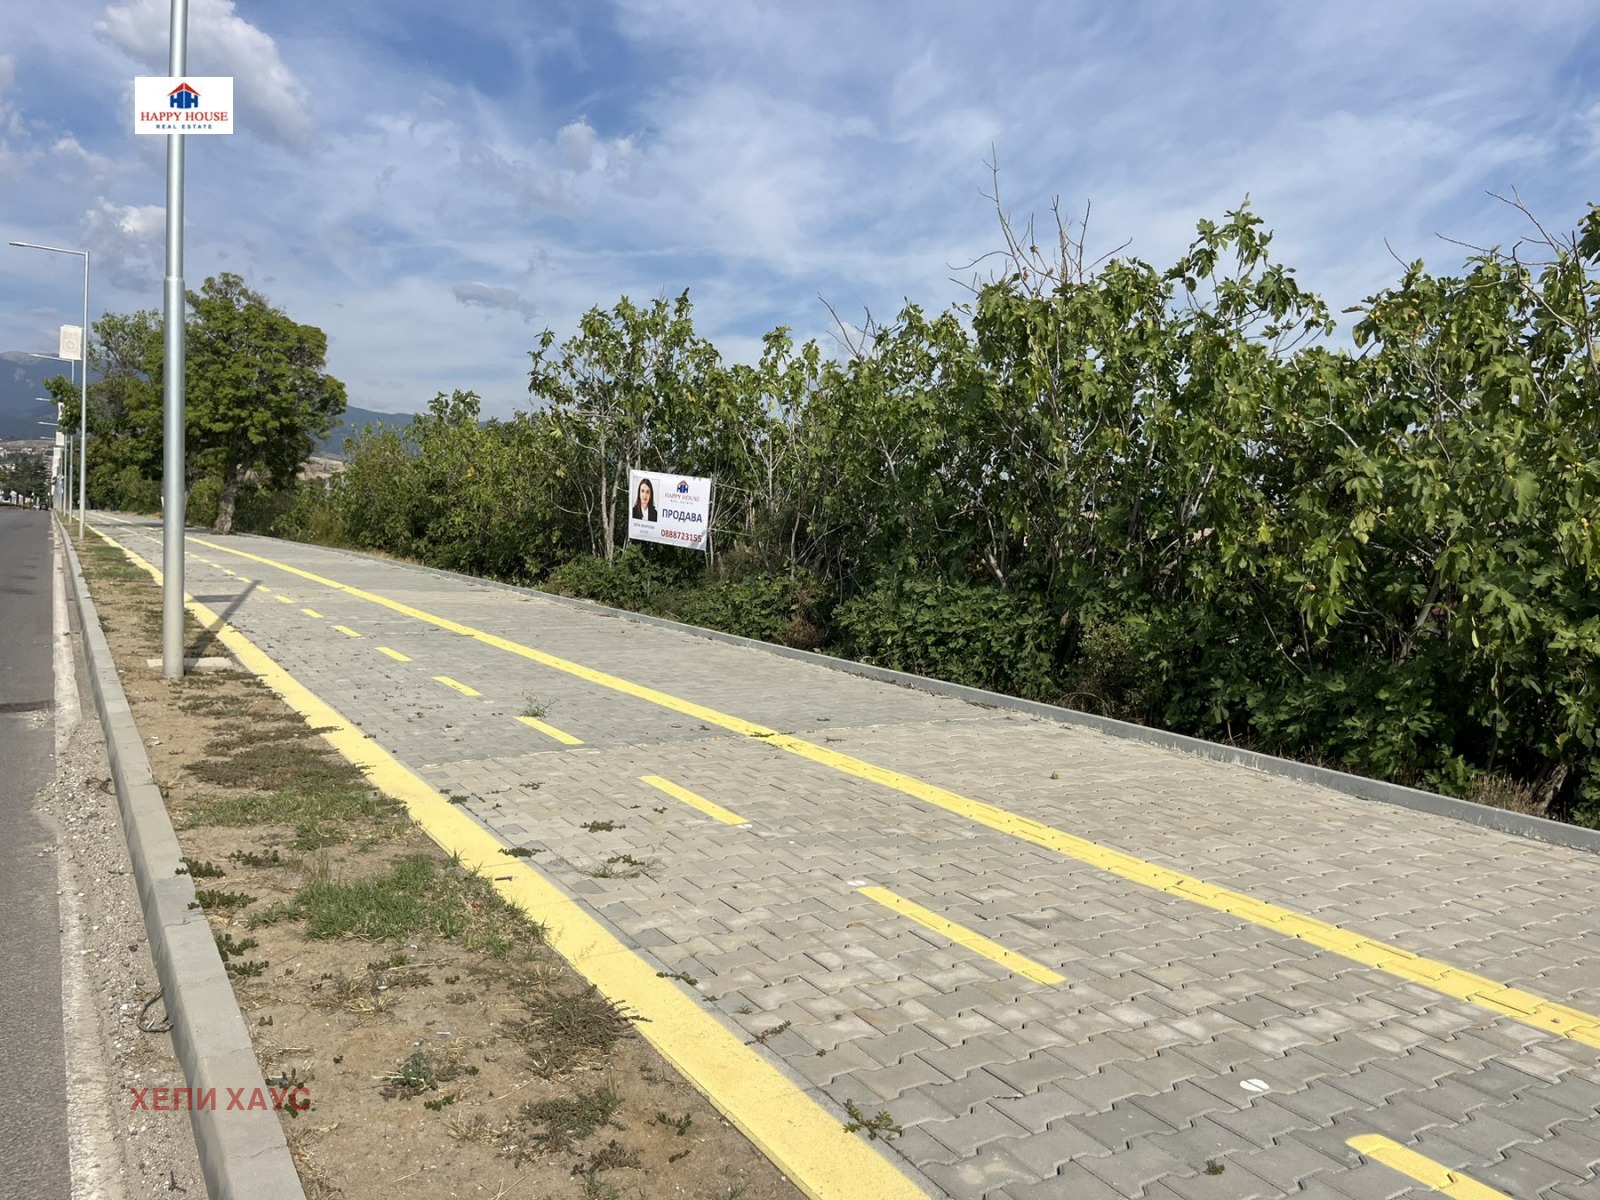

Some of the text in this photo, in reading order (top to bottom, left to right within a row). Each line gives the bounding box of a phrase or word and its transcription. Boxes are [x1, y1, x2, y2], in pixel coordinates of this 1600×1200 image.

[664, 492, 681, 500] HAPPY
[662, 508, 703, 523] ПРОДАВА
[661, 529, 702, 543] 0888723155
